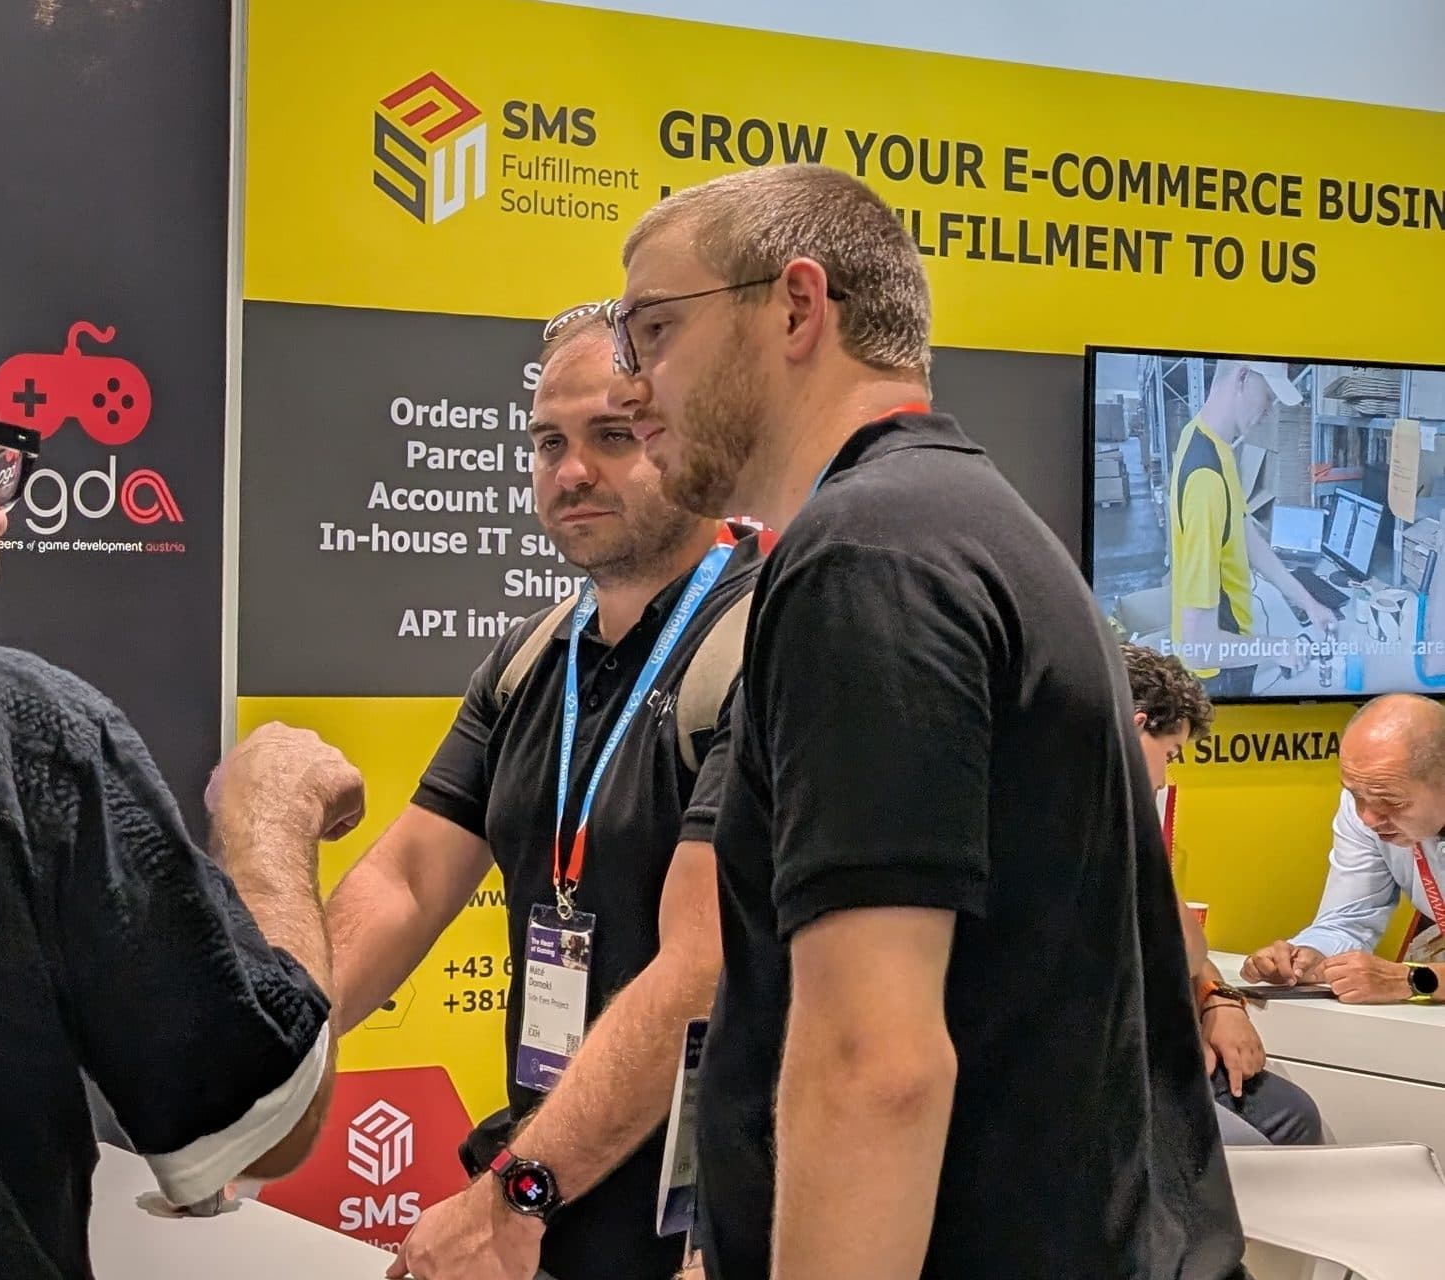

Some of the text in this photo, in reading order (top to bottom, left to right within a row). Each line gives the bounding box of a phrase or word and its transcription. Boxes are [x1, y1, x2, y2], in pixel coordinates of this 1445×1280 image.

[502, 100, 596, 147] SMS
[502, 154, 639, 190] Fulfillment
[660, 110, 828, 166] GROW
[845, 129, 986, 189] YOUR
[1003, 148, 1300, 217] E-COMMERCE
[500, 189, 619, 221] Solutions
[1186, 234, 1244, 280] TO
[1260, 239, 1317, 287] US
[390, 397, 498, 430] Orders
[406, 441, 503, 473] Parcel
[367, 482, 499, 513] Account
[38, 541, 69, 553] game
[73, 539, 142, 554] development
[146, 540, 186, 552] austria
[319, 522, 468, 555] In-house
[477, 527, 512, 555] IT
[398, 609, 456, 638] API
[1160, 639, 1211, 661] Every
[1219, 638, 1290, 662] product
[1294, 639, 1360, 657] treated
[1194, 731, 1341, 764] SLOVAKIA
[444, 956, 493, 979] +43
[443, 989, 507, 1013] +381
[339, 1192, 421, 1231] SMS
